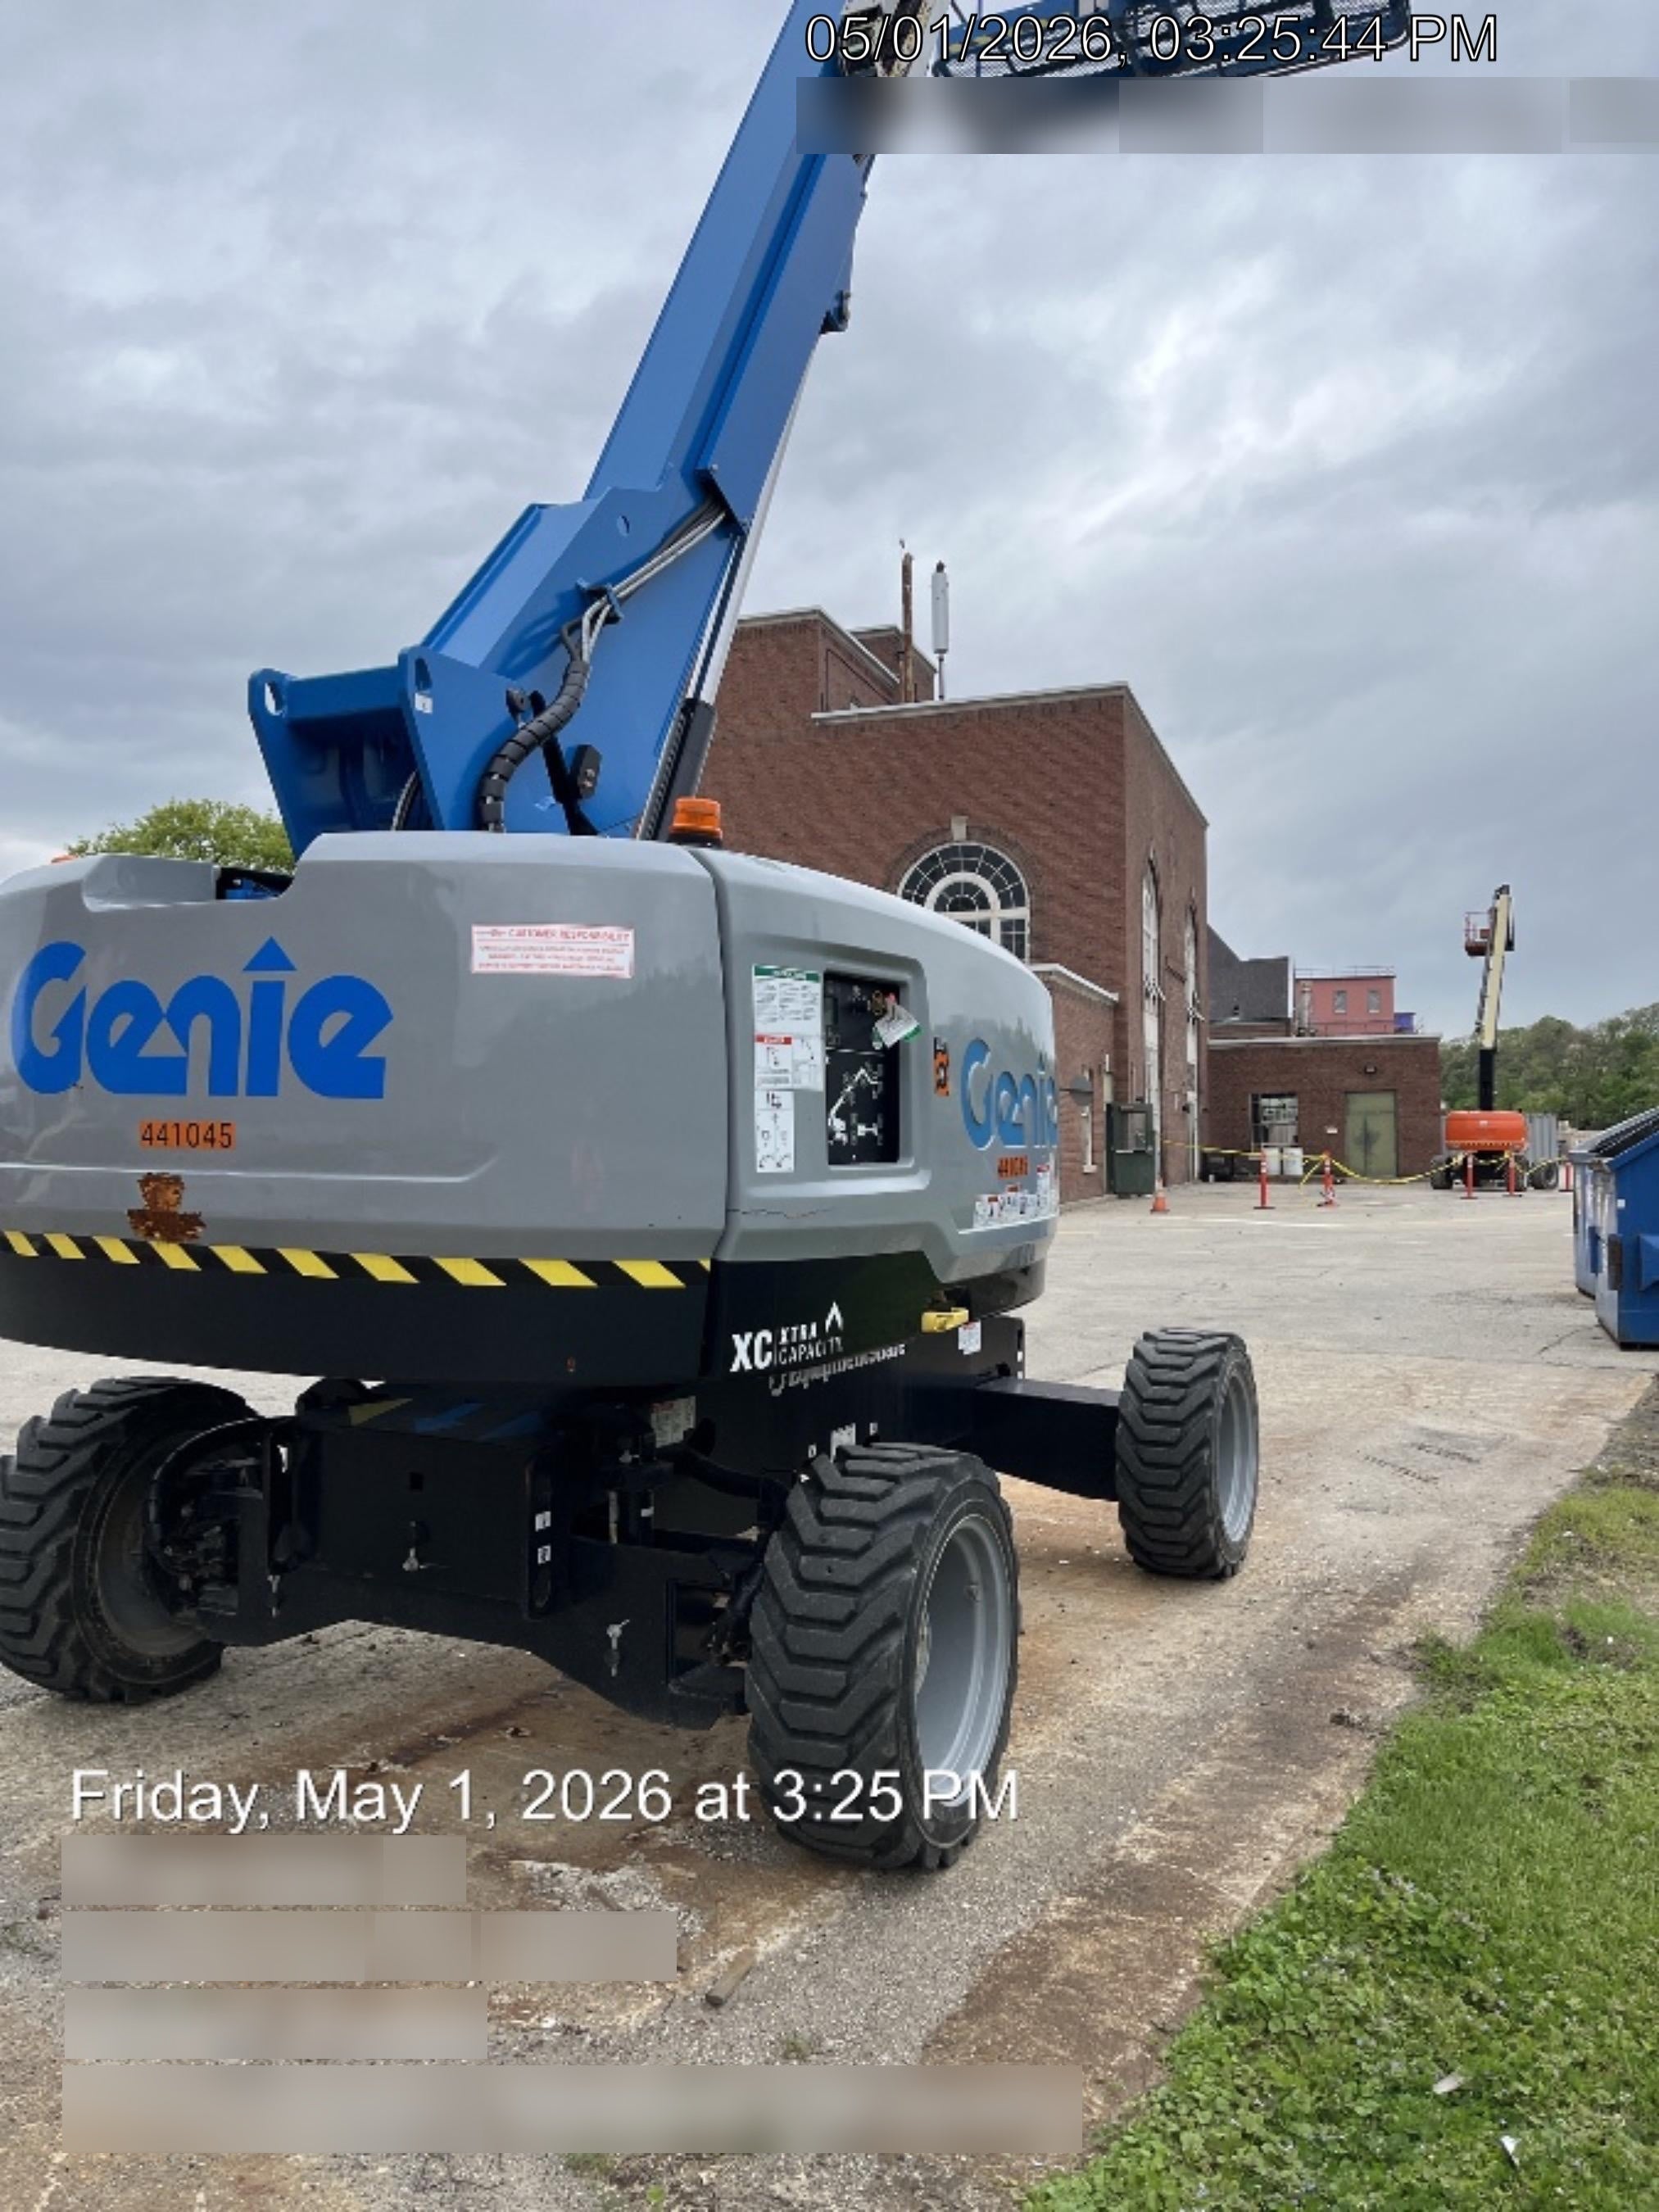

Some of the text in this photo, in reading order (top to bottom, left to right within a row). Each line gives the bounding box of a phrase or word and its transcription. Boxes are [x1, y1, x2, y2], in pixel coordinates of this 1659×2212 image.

[11, 936, 394, 1099] Genie
[141, 1122, 233, 1149] 441045
[729, 1329, 773, 1372] XC
[779, 1321, 818, 1345] XTRA
[779, 1336, 843, 1366] CAPACITY
